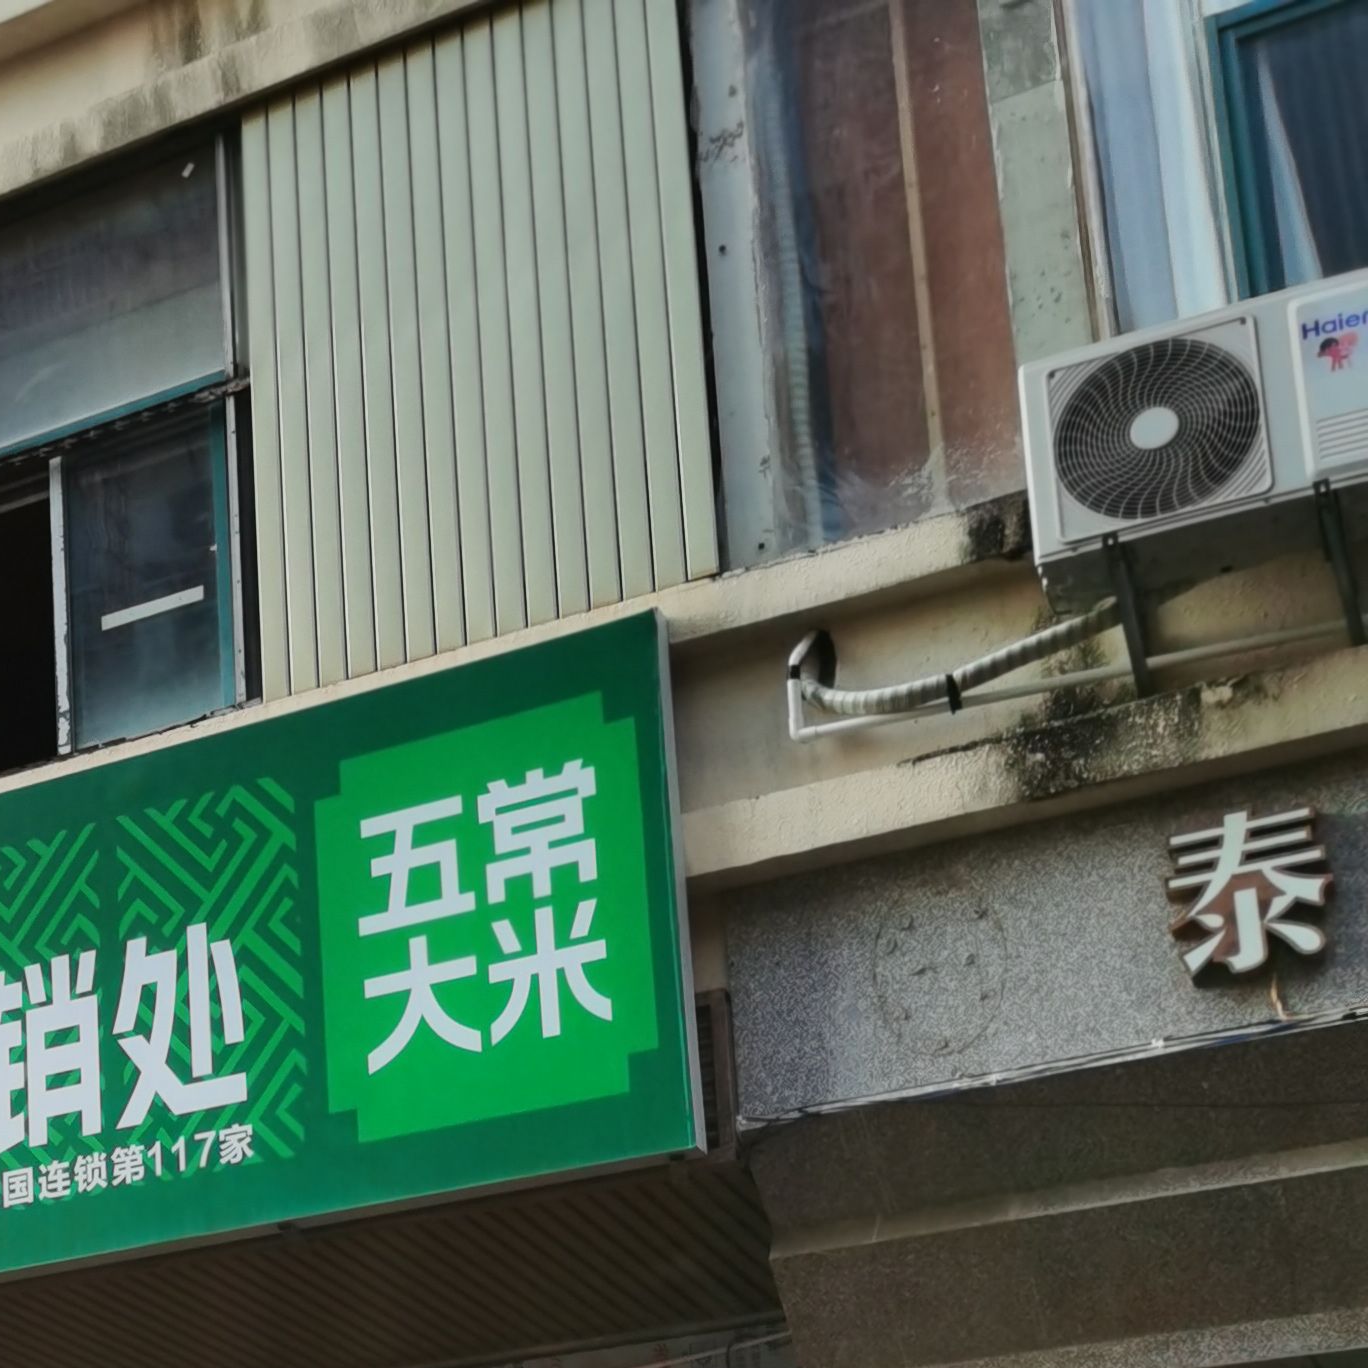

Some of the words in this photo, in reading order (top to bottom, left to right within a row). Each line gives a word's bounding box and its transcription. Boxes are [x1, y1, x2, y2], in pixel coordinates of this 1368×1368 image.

[1301, 311, 1368, 340] Haier
[358, 759, 600, 935] 五常
[1168, 808, 1330, 978] 泰
[364, 898, 613, 1075] 大米
